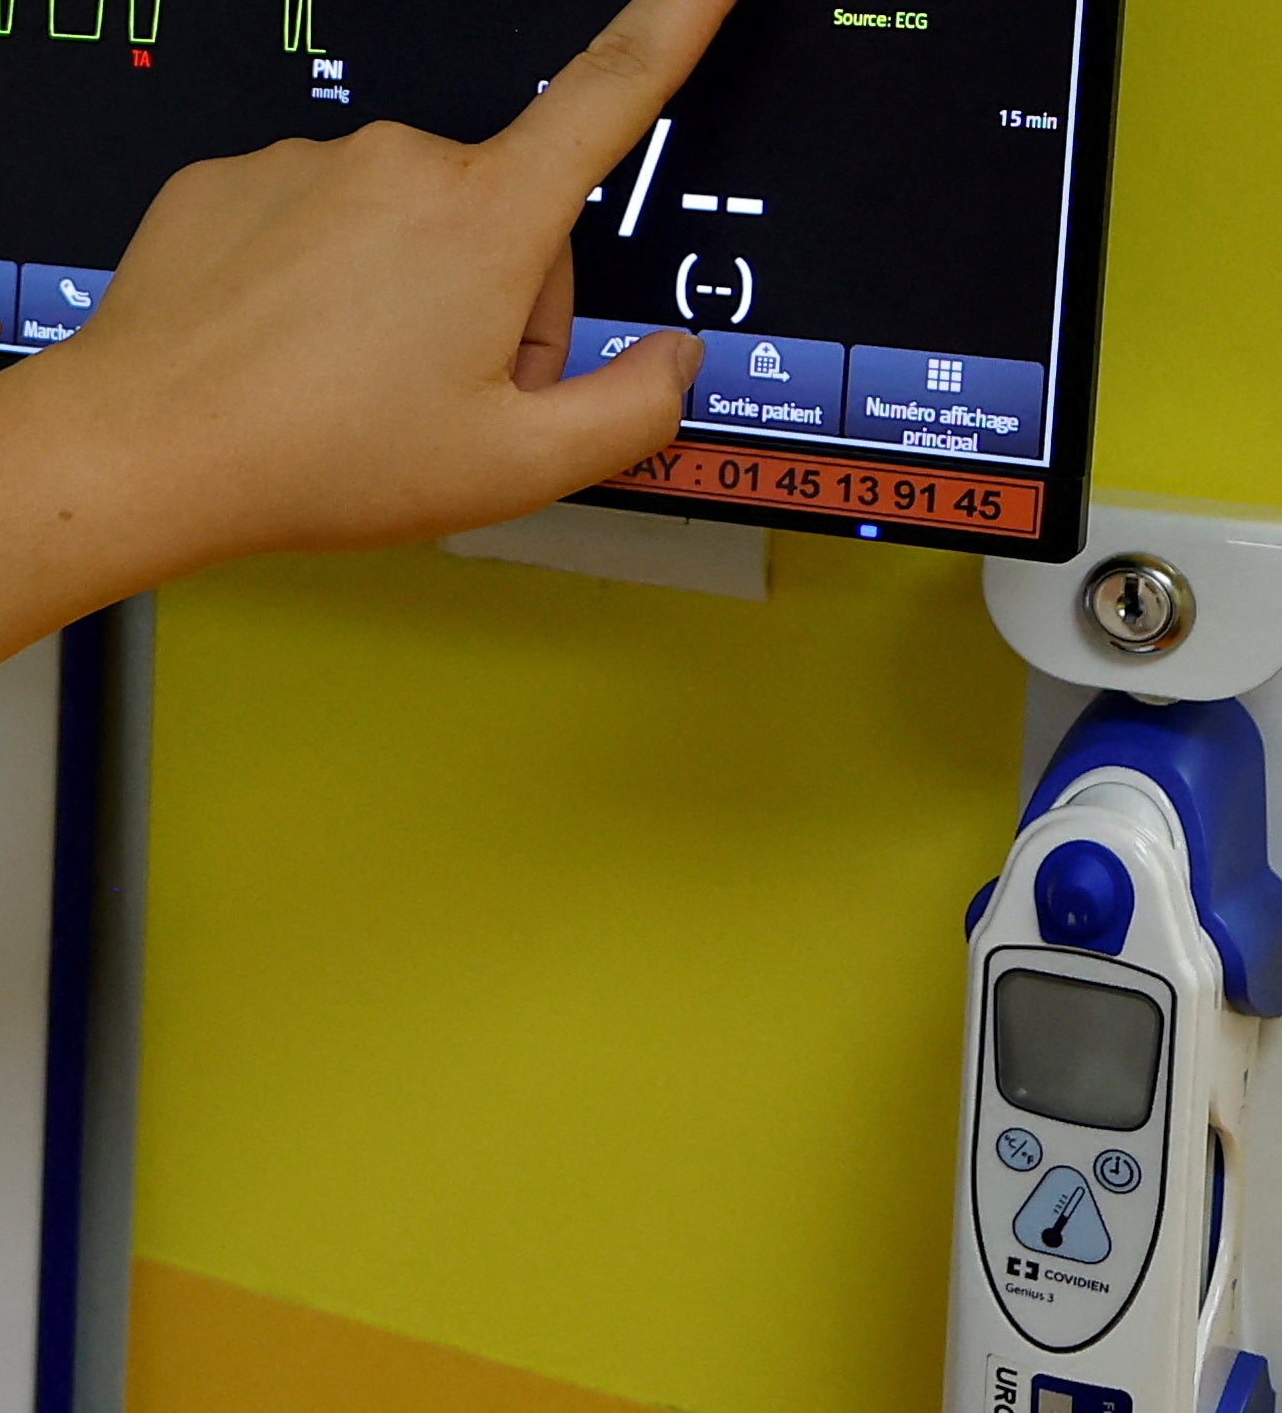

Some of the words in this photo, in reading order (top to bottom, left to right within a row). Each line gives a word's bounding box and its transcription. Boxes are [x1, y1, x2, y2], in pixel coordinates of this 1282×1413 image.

[833, 8, 893, 30] Source:
[894, 10, 928, 30] ECG
[130, 49, 152, 68] TA
[312, 60, 344, 81] PNI
[311, 85, 351, 105] mmHg
[999, 109, 1022, 129] 15
[1026, 111, 1059, 131] min
[708, 394, 760, 418] Sortie
[762, 401, 823, 426] patient
[866, 396, 936, 423] Numéro
[938, 403, 1020, 434] affichage
[902, 427, 979, 454] principal
[718, 459, 760, 493] 01
[775, 466, 822, 500] 45
[836, 472, 881, 507] 13
[893, 479, 937, 514] 91
[952, 487, 1003, 522] 45
[1004, 1282, 1046, 1303] Genius
[1046, 1291, 1055, 1304] 3
[1043, 1269, 1112, 1295] COVIDIEN
